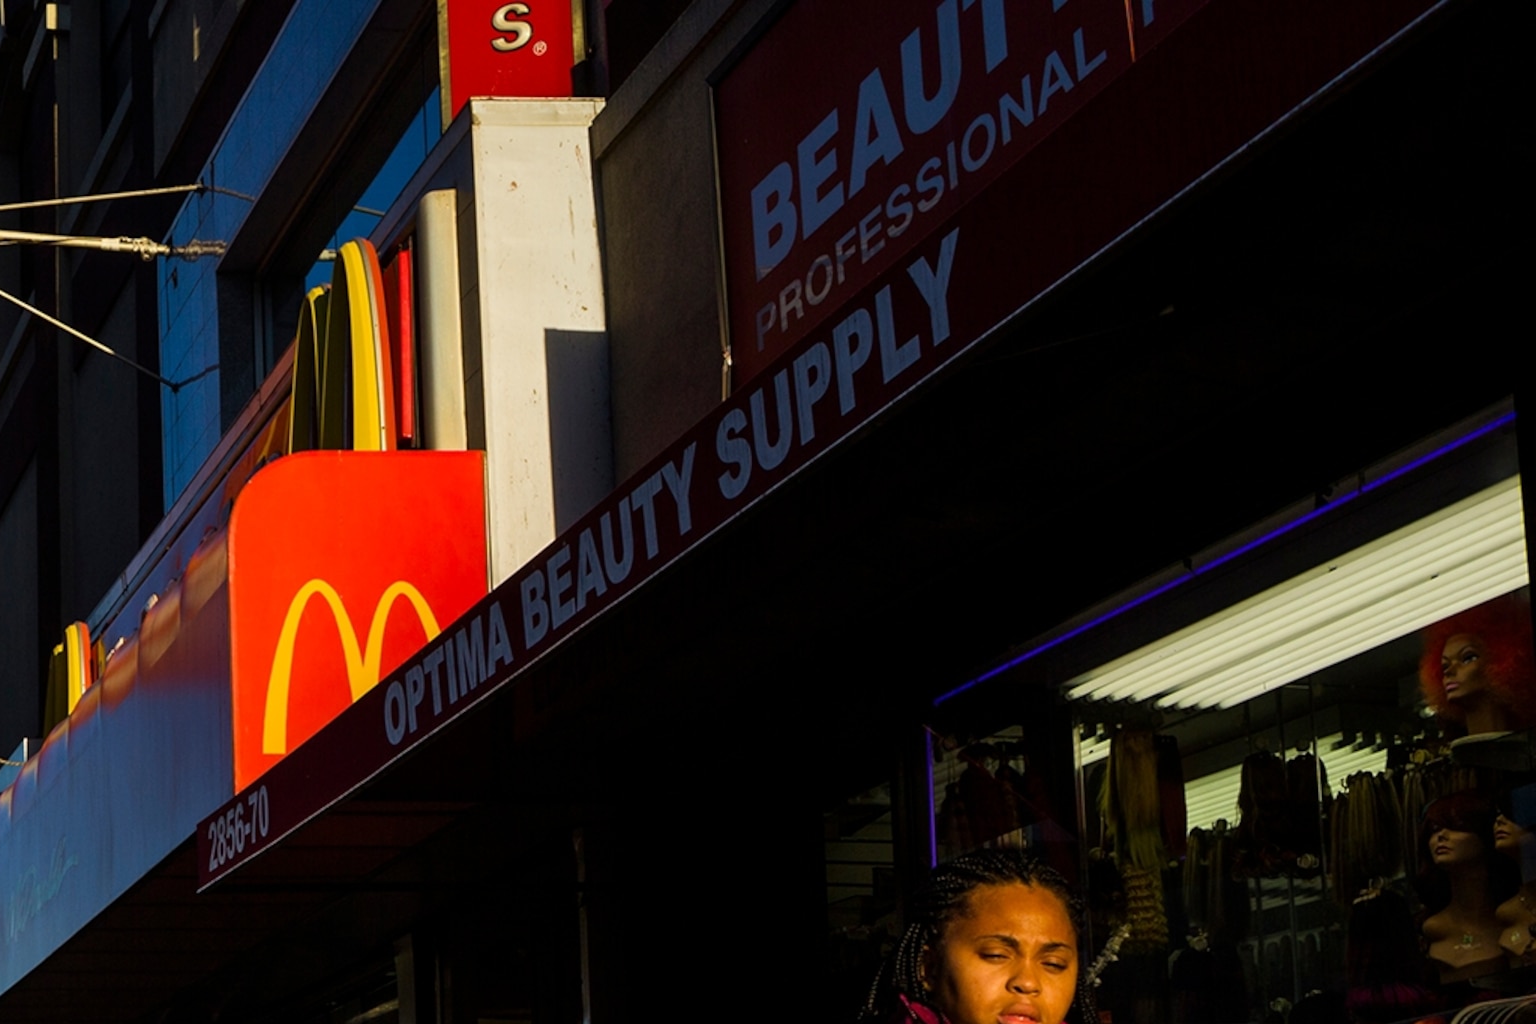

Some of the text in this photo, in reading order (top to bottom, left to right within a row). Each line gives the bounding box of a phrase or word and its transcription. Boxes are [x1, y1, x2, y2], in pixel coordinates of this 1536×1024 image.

[750, 0, 1064, 284] BEAUT
[756, 26, 1108, 352] PROFESSIONAL
[383, 226, 961, 746] OPTIMA BEAUTY SUPPLY
[207, 785, 270, 872] 2856-70
